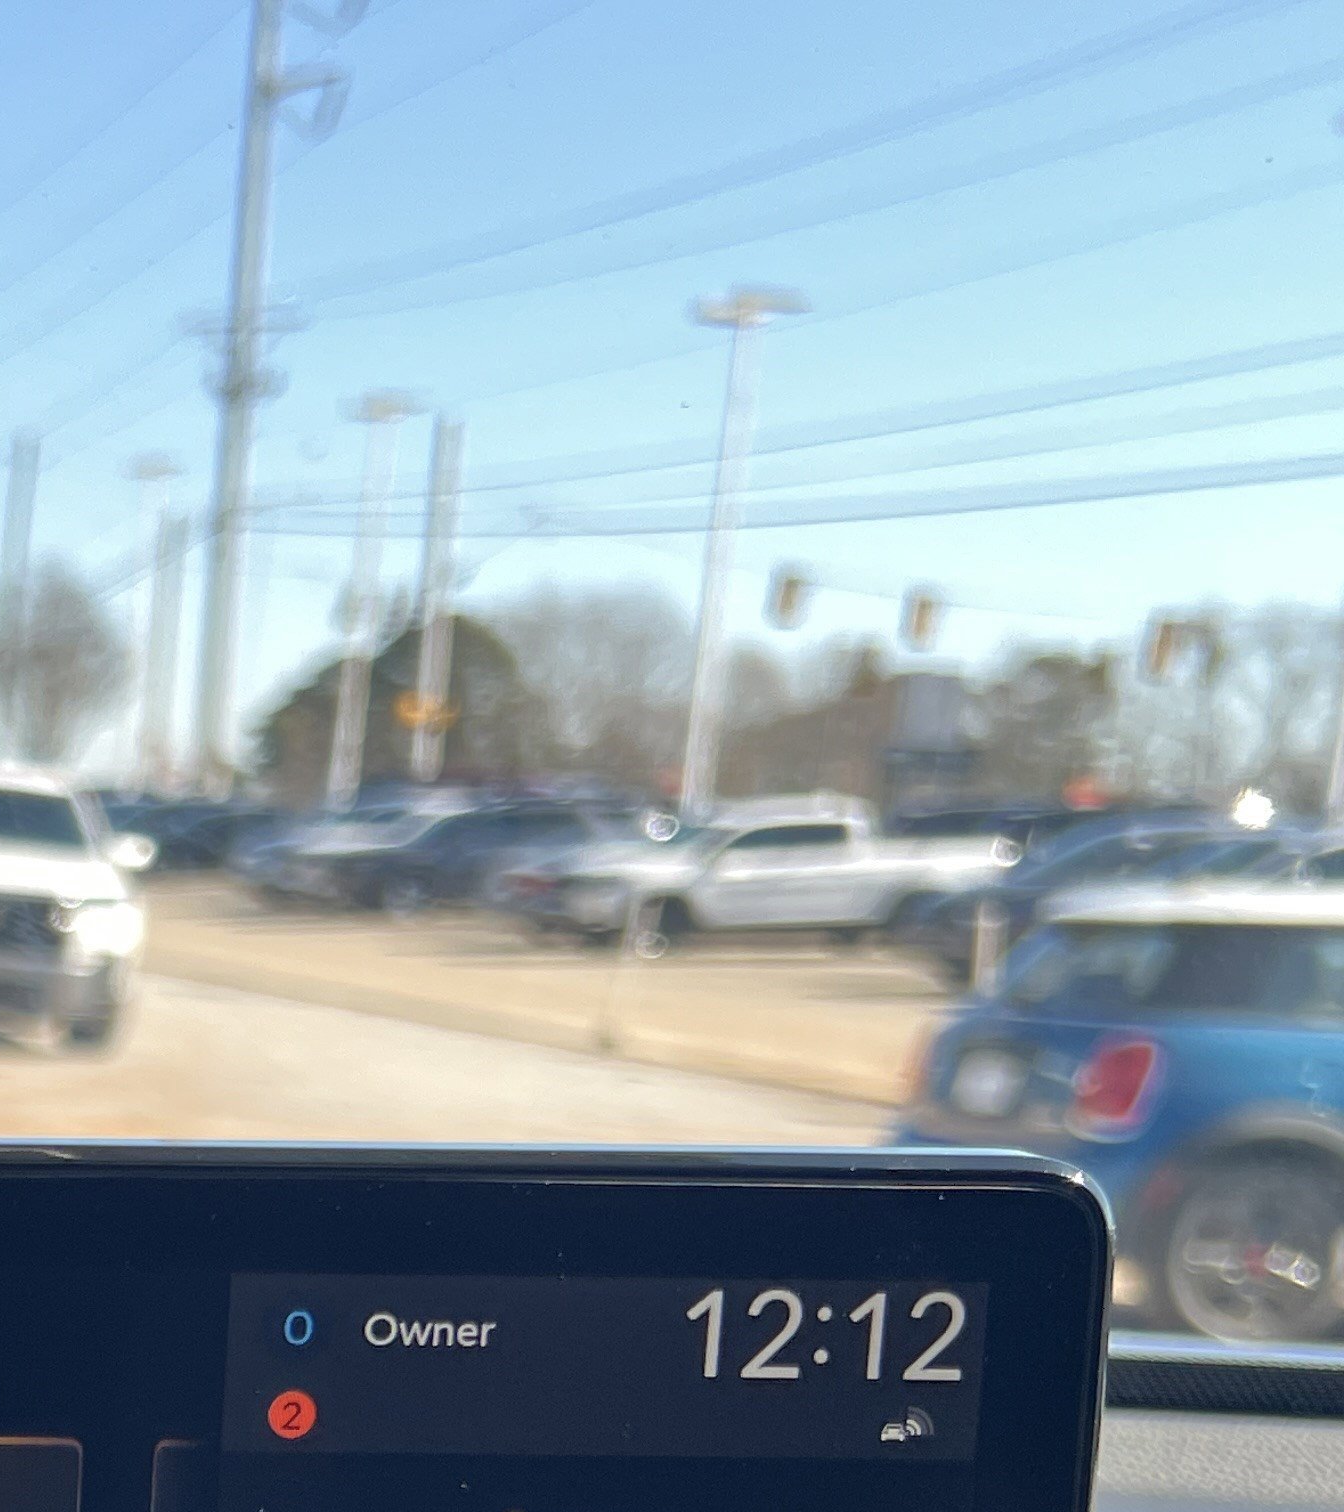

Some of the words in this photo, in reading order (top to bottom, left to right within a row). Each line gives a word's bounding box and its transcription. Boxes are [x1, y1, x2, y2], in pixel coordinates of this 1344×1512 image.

[364, 1313, 497, 1348] Owner
[686, 1289, 966, 1382] 12:12
[281, 1401, 301, 1431] 2
